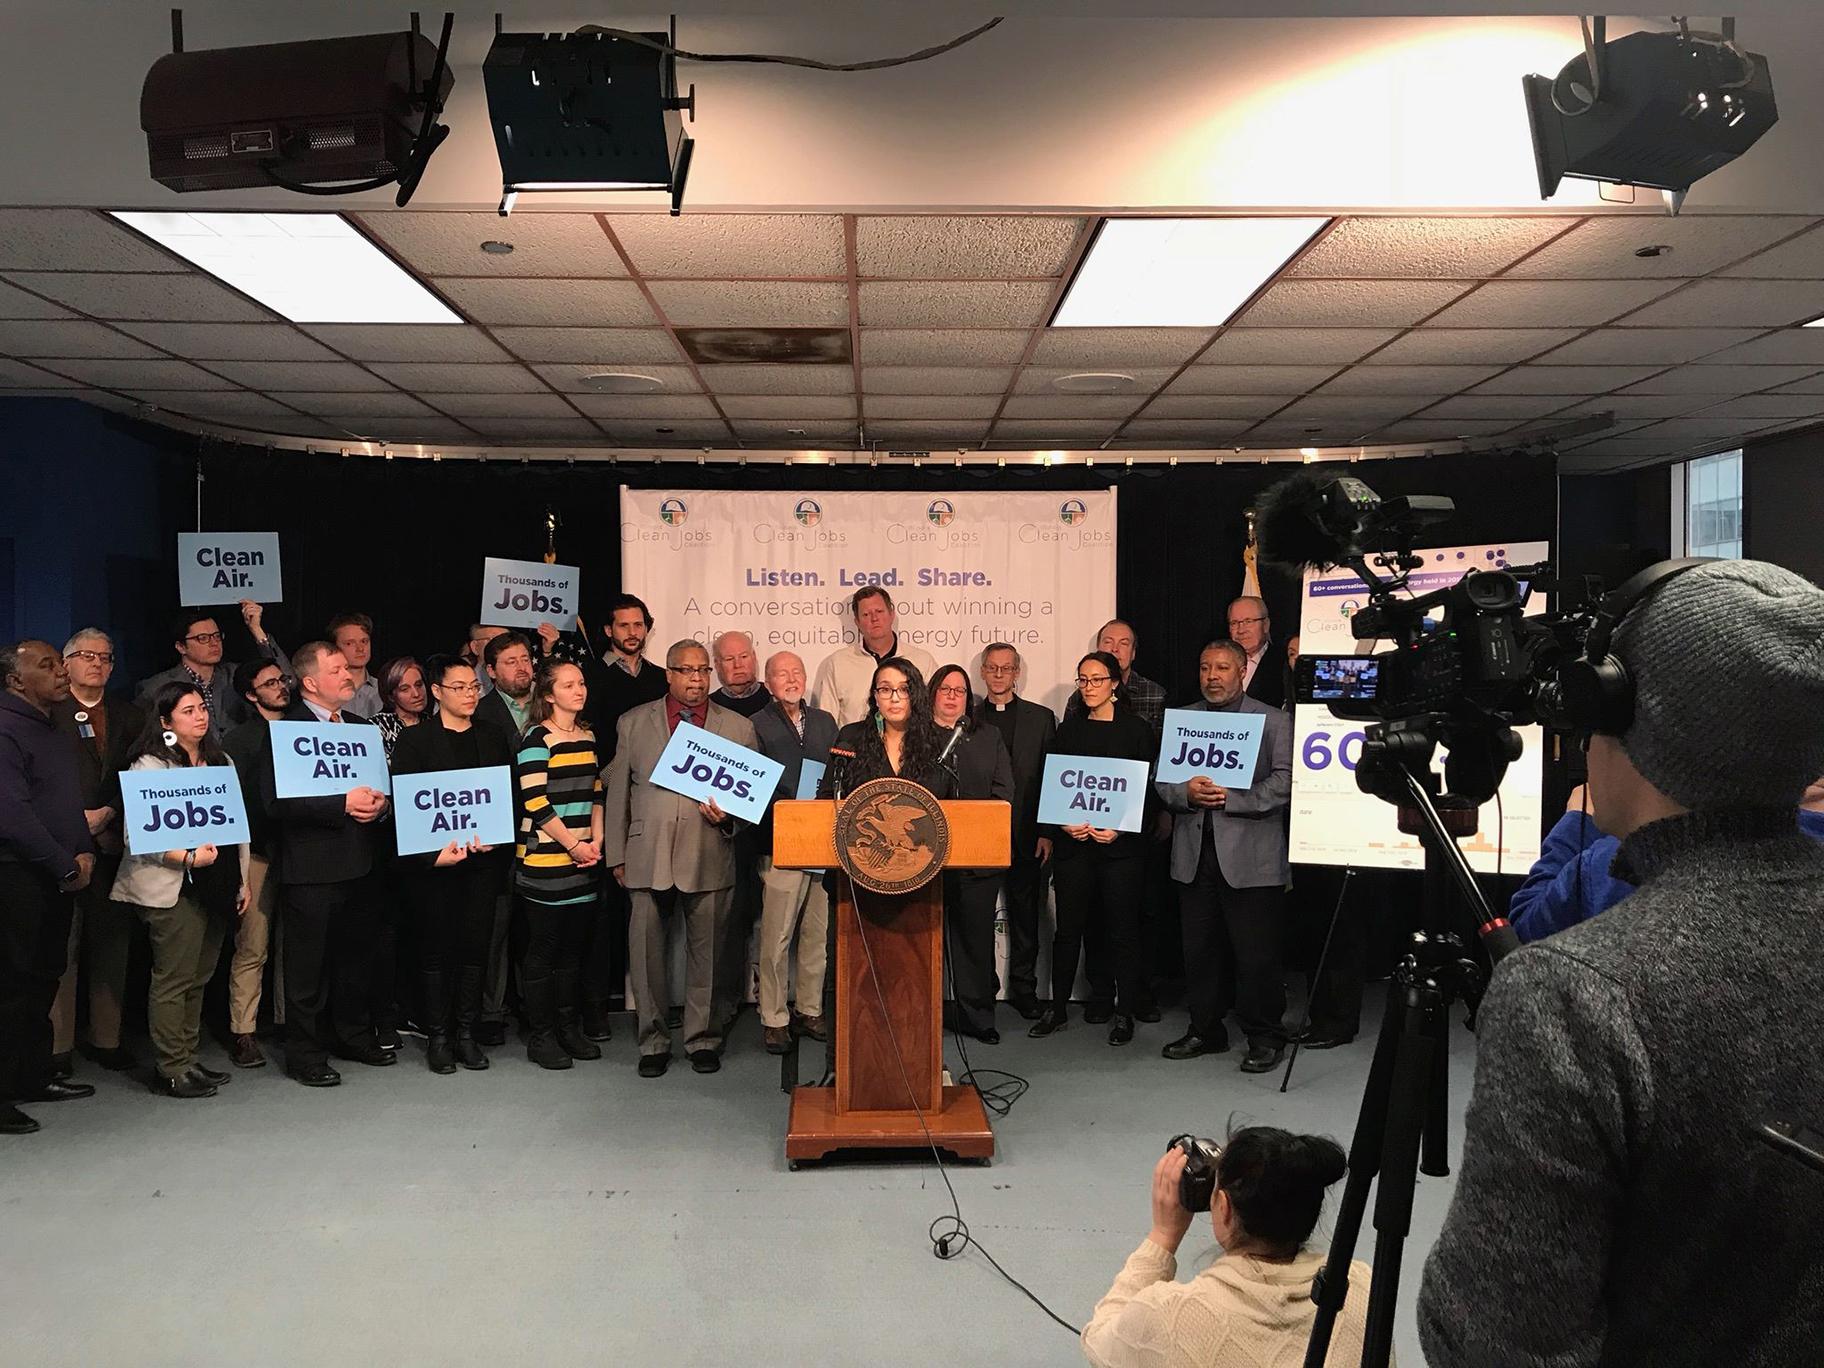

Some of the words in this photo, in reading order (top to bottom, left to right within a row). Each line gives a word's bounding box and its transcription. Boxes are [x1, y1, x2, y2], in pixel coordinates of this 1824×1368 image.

[621, 522, 669, 543] Clean
[670, 528, 712, 551] Jobs
[753, 523, 804, 544] Clean
[805, 528, 846, 551] Jobs
[886, 523, 937, 545] Clean
[938, 528, 978, 551] Jobs
[1018, 523, 1068, 544] Clean
[1069, 528, 1112, 551] Jobs
[196, 547, 265, 568] Clean
[212, 568, 254, 589] Air.
[496, 574, 557, 589] Thousands
[557, 580, 570, 590] of
[746, 568, 825, 587] Listen.
[839, 567, 904, 587] Lead.
[917, 568, 992, 587] Share.
[1326, 583, 1370, 591] conversation
[493, 588, 569, 615] Jobs.
[683, 597, 701, 616] A
[943, 597, 1033, 619] winning
[1041, 602, 1053, 616] a
[692, 626, 760, 647] clen,
[768, 626, 863, 648] equitabl
[896, 629, 963, 648] nergy
[971, 625, 1044, 645] future.
[1306, 619, 1347, 634] Clean
[1176, 727, 1235, 741] Thousands
[1237, 731, 1250, 742] of
[293, 736, 368, 757] Clean
[1169, 741, 1244, 770] Jobs.
[1302, 731, 1368, 770] 60
[312, 759, 358, 779] Air.
[686, 739, 750, 772] Thousands
[751, 767, 766, 778] of
[671, 754, 755, 803] Jobs.
[1059, 769, 1128, 793] Clean
[139, 785, 212, 801] Thousands
[214, 783, 227, 796] of
[413, 788, 492, 811] Clean
[864, 786, 882, 798] THE
[884, 783, 915, 794] STATE
[1069, 791, 1111, 813] Air.
[142, 800, 235, 833] Jobs.
[430, 809, 478, 834] Air.
